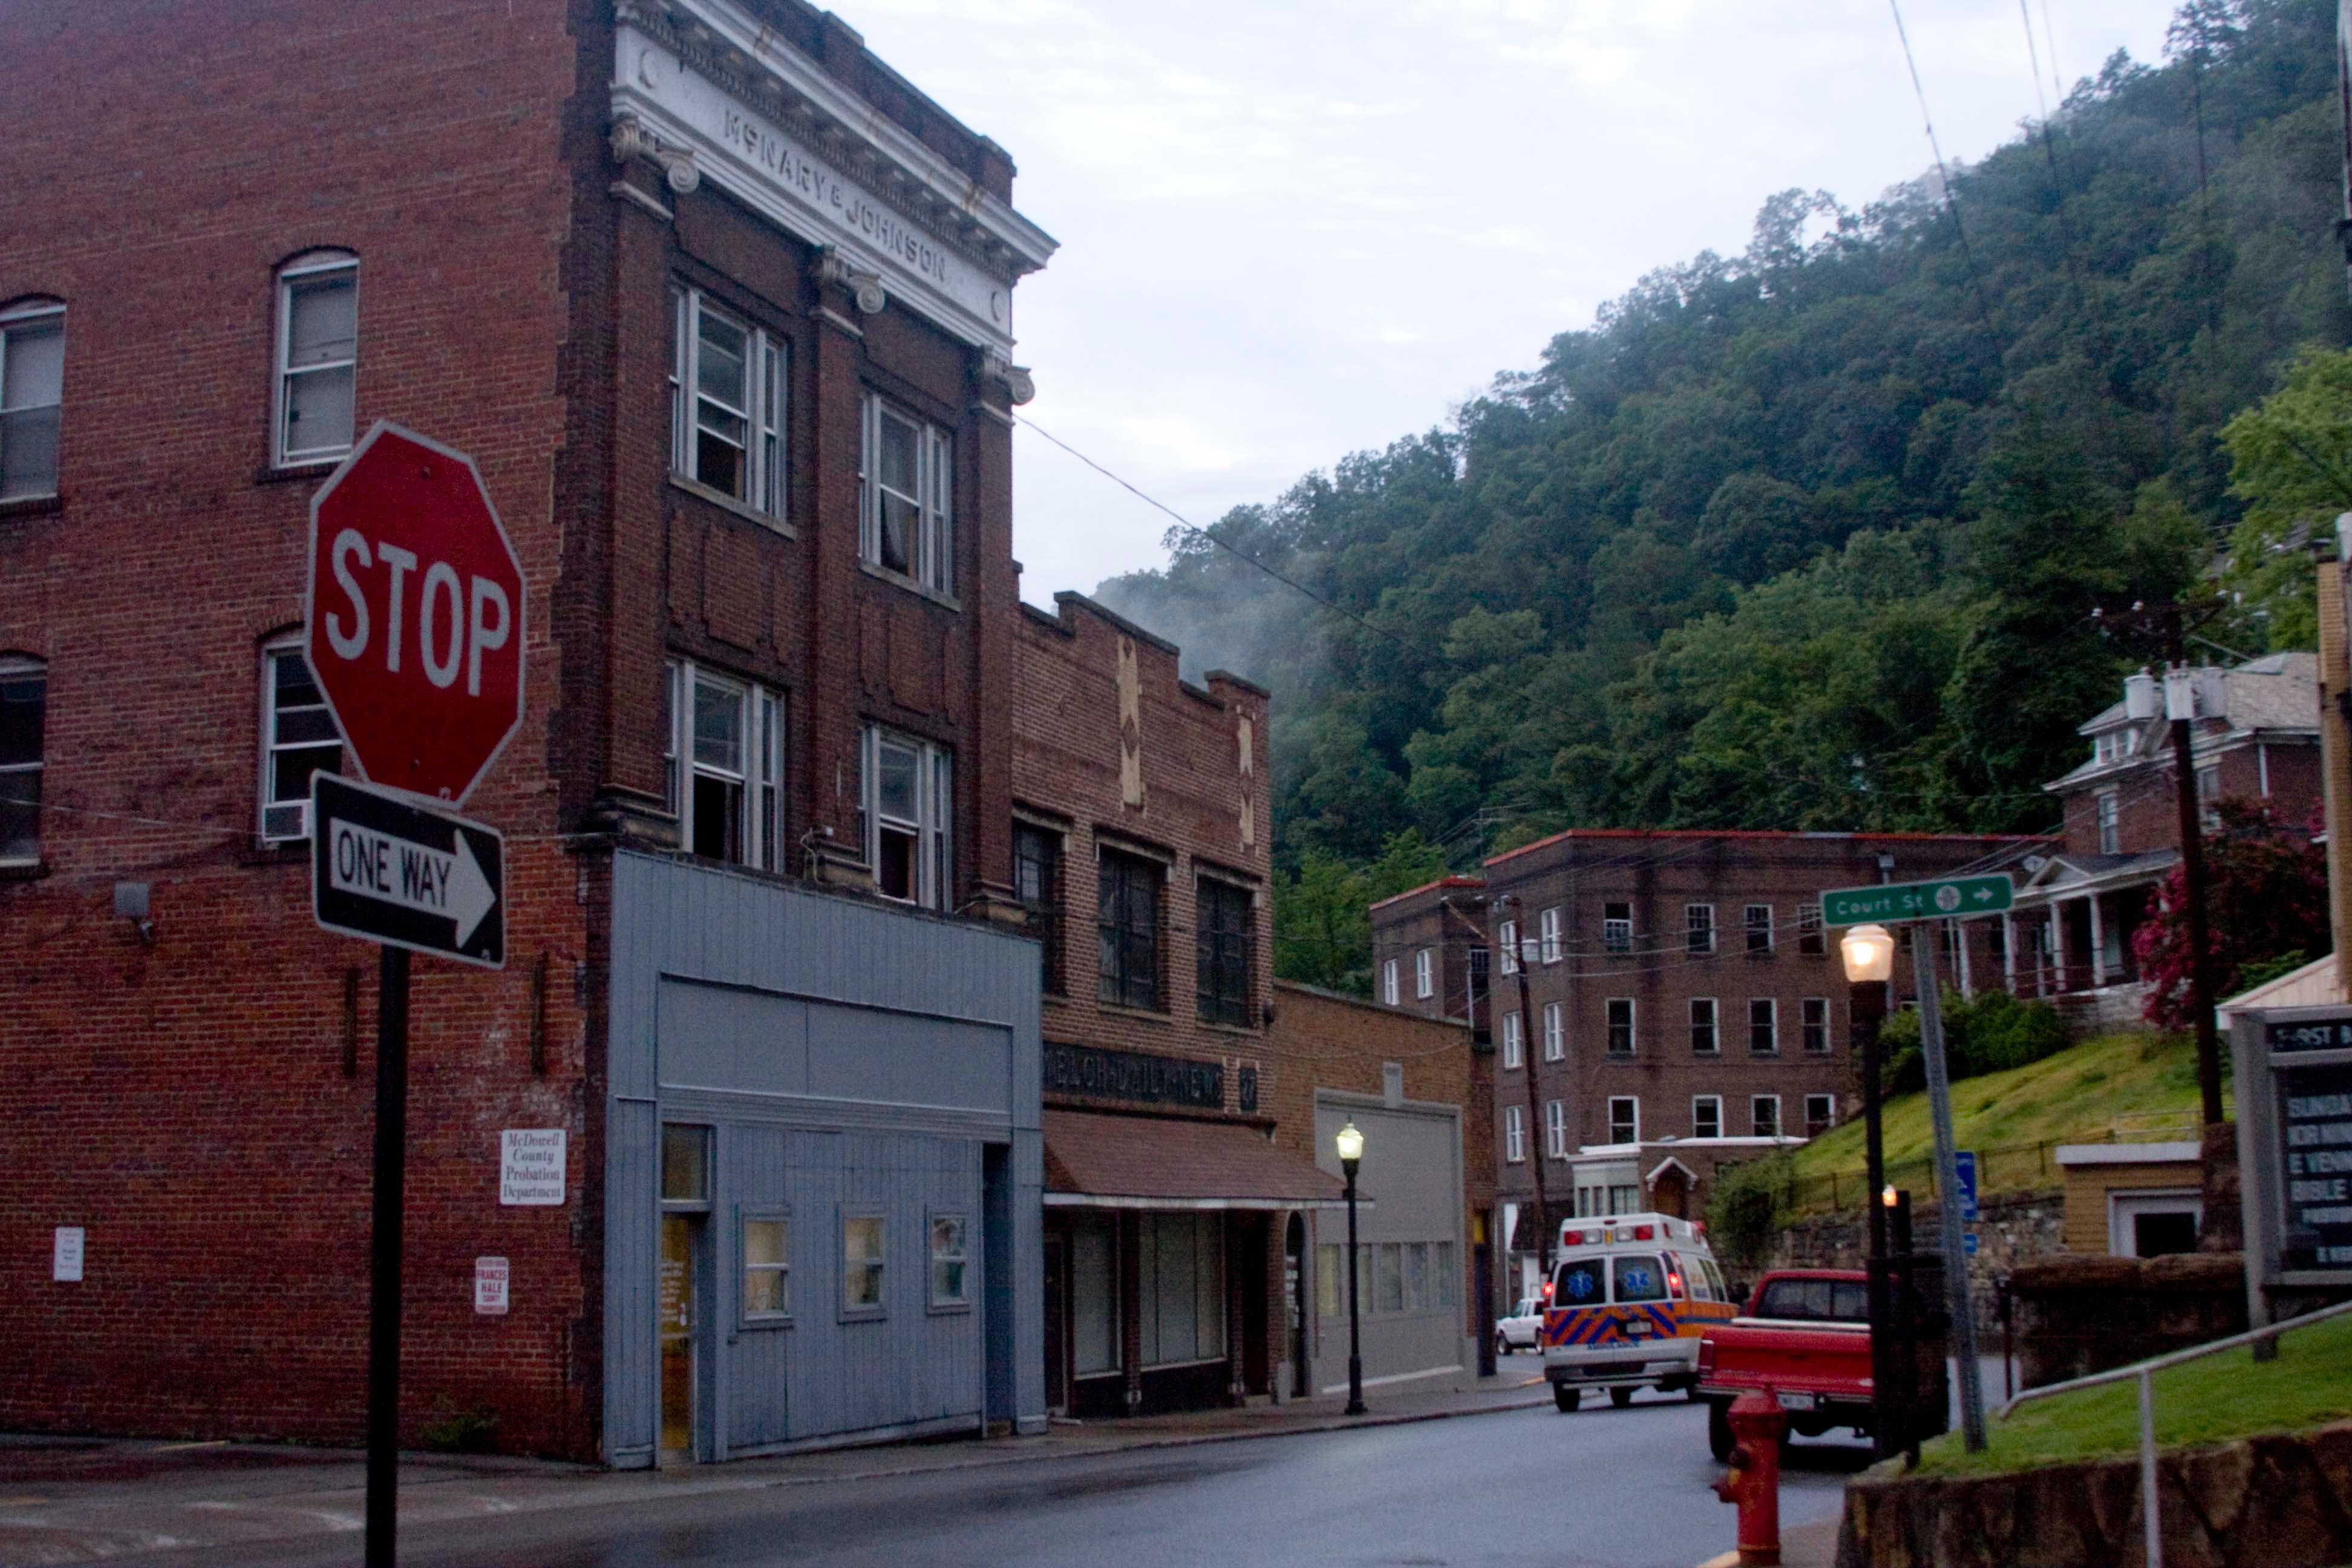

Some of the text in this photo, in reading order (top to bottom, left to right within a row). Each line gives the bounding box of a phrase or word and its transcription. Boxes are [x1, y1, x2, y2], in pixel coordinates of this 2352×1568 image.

[846, 199, 946, 283] JOHNSON
[325, 528, 511, 697] STOP
[338, 828, 452, 909] ONE WAY
[1837, 894, 1923, 915] Court St
[509, 1133, 560, 1146] McDowell
[513, 1148, 554, 1166] County
[506, 1166, 560, 1181] Probation
[503, 1184, 561, 1201] Department
